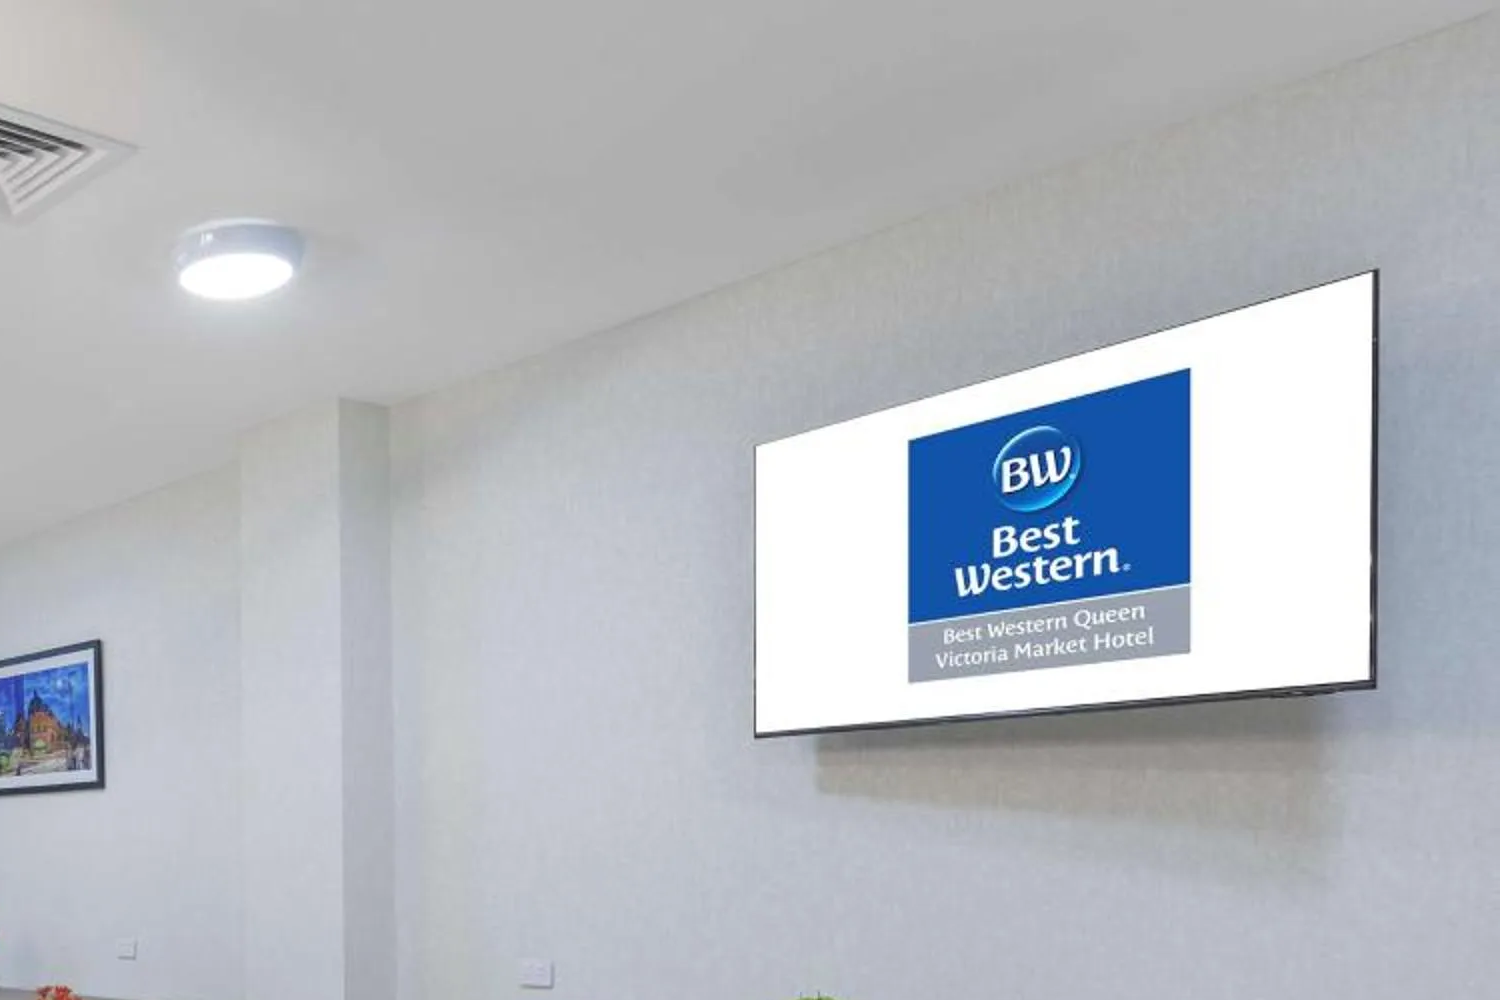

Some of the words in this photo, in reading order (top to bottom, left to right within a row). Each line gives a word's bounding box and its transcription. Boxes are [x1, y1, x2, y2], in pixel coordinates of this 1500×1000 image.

[1001, 446, 1072, 494] BW
[992, 515, 1081, 559] Best
[954, 547, 1121, 598] Western
[942, 625, 982, 645] Best
[987, 615, 1068, 639] Western
[1072, 603, 1146, 628] Queen
[935, 648, 1009, 669] Victoria
[1014, 637, 1088, 660] Market
[1094, 626, 1155, 650] Hotel
